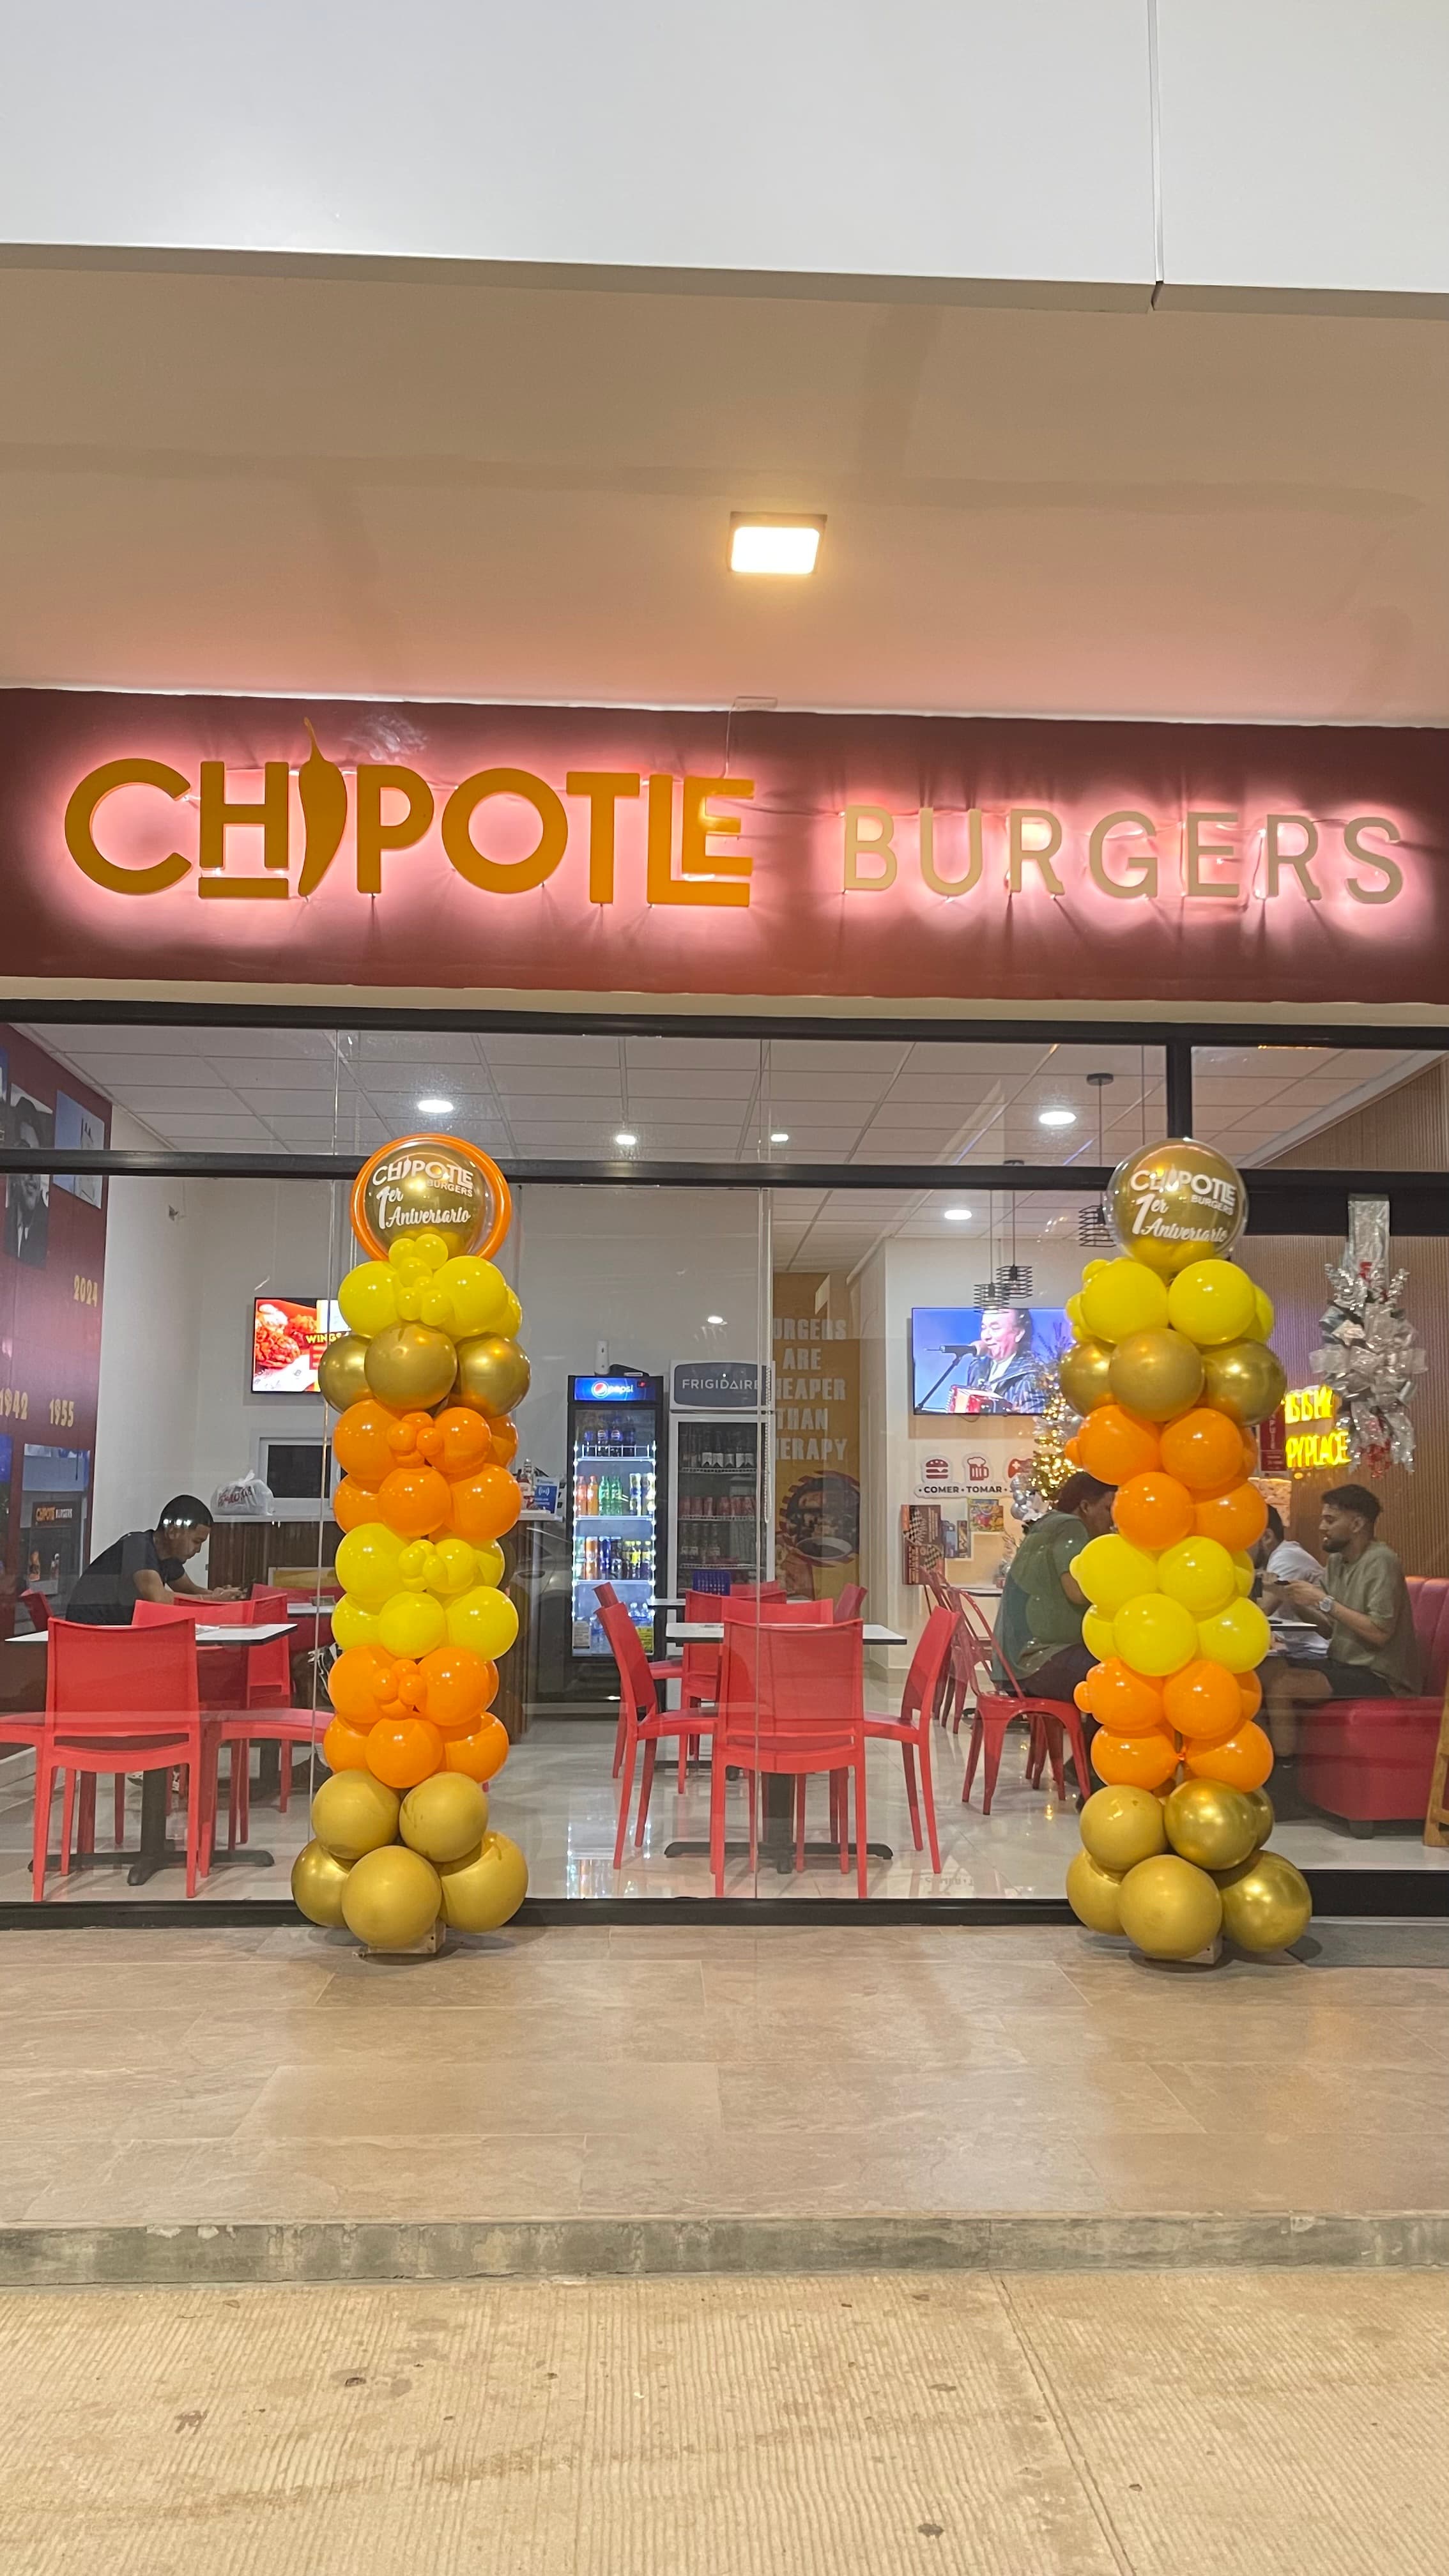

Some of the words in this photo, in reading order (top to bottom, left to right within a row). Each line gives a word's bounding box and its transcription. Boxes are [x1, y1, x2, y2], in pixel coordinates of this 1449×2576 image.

[65, 717, 755, 907] CHIPOTLE
[843, 804, 1404, 905] BURGERS
[372, 1155, 474, 1190] CHIPOTLE
[427, 1179, 473, 1197] BURGERS
[1190, 1194, 1234, 1216] BURGERS
[386, 1206, 471, 1228] Aniversario
[1140, 1217, 1228, 1243] Aniversario
[73, 1275, 98, 1307] 2024
[773, 1318, 847, 1340] URGERS
[783, 1348, 821, 1370] ARE
[776, 1377, 845, 1400] HEAPER
[0, 1387, 28, 1420] 1942
[50, 1399, 74, 1427] 1955
[776, 1407, 828, 1430] THAN
[776, 1438, 847, 1460] ERAPY
